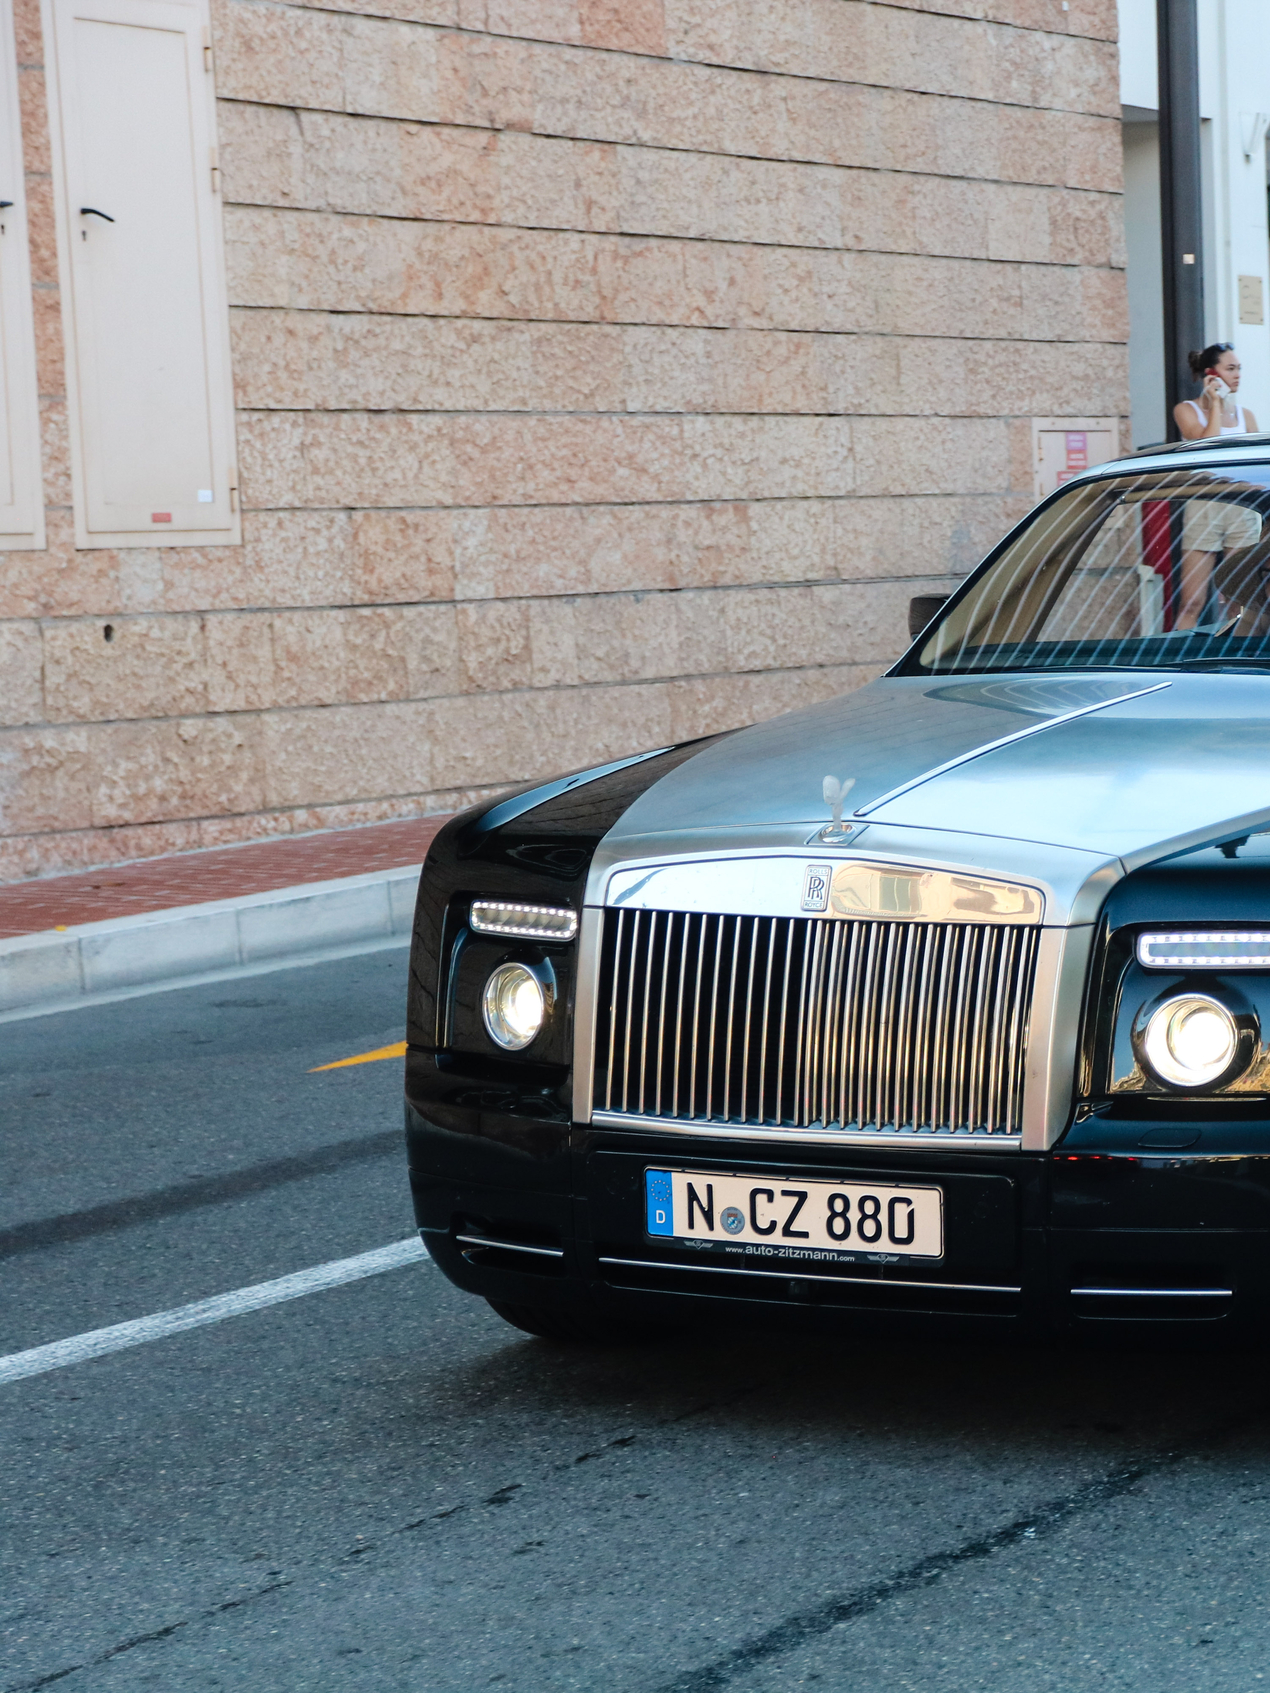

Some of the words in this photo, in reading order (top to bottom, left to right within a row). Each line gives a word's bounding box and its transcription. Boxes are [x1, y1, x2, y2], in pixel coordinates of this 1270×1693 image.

[655, 1209, 666, 1224] D
[686, 1182, 714, 1231] N
[749, 1187, 809, 1239] CZ
[826, 1193, 915, 1245] 880
[725, 1245, 855, 1262] www.auto-zitzmann.com
